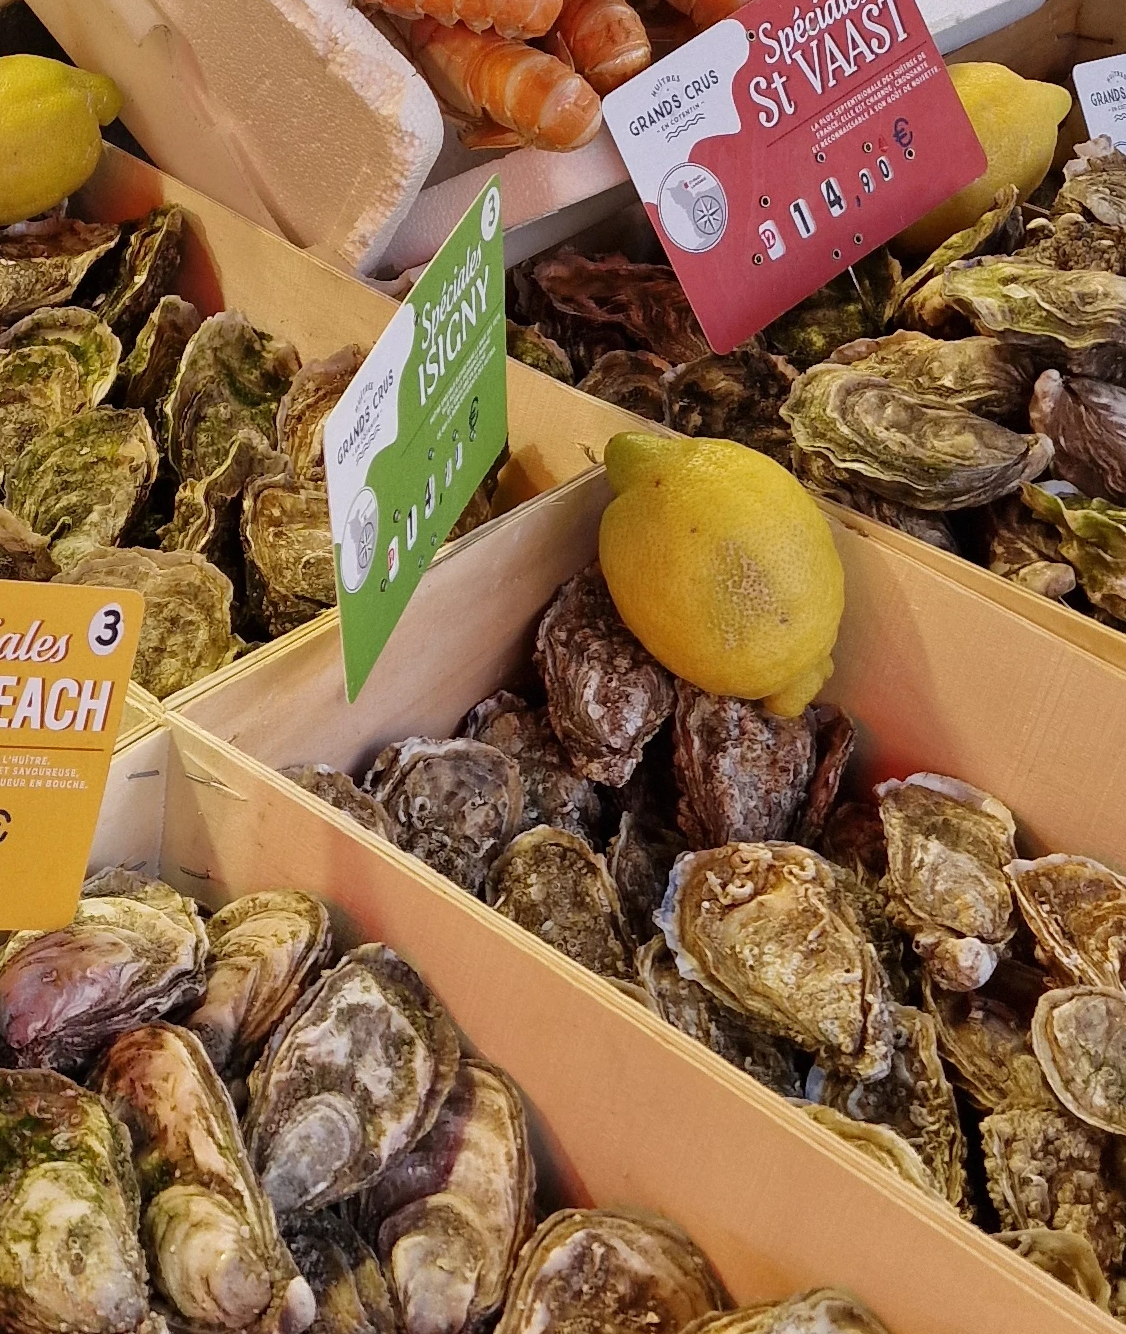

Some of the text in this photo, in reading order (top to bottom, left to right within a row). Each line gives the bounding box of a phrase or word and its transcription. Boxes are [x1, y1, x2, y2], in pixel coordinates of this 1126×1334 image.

[629, 69, 719, 136] GRANDS CRUS
[651, 74, 681, 97] HUÎTRES
[749, 70, 796, 129] St
[670, 102, 700, 125] COTENTIN
[487, 196, 497, 226] 3
[421, 241, 482, 348] Spéciales
[416, 265, 491, 406] ISIGNY
[337, 368, 394, 466] GRANDS CRUS
[96, 609, 120, 647] 3
[29, 778, 42, 788] EN
